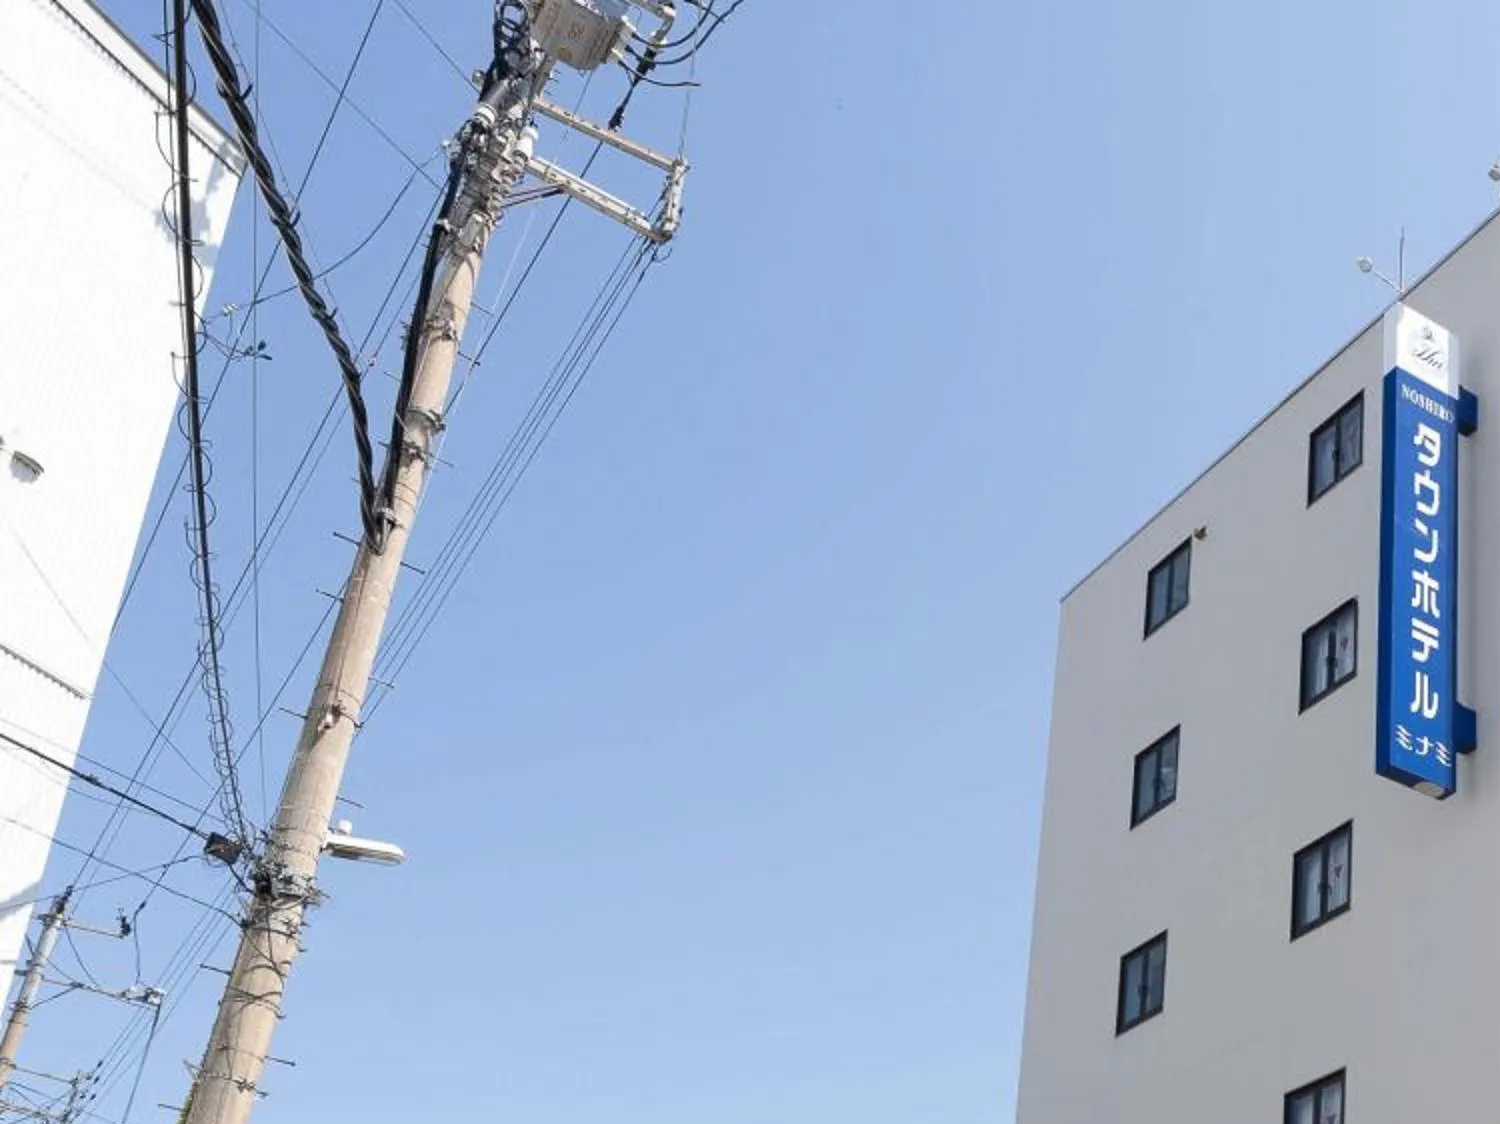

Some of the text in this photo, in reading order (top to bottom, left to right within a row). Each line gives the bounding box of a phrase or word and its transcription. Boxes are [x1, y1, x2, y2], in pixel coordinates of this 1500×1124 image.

[1401, 383, 1455, 424] NOSHIRO
[1410, 422, 1441, 719] タウンホテル
[1395, 724, 1452, 767] ミナミ
